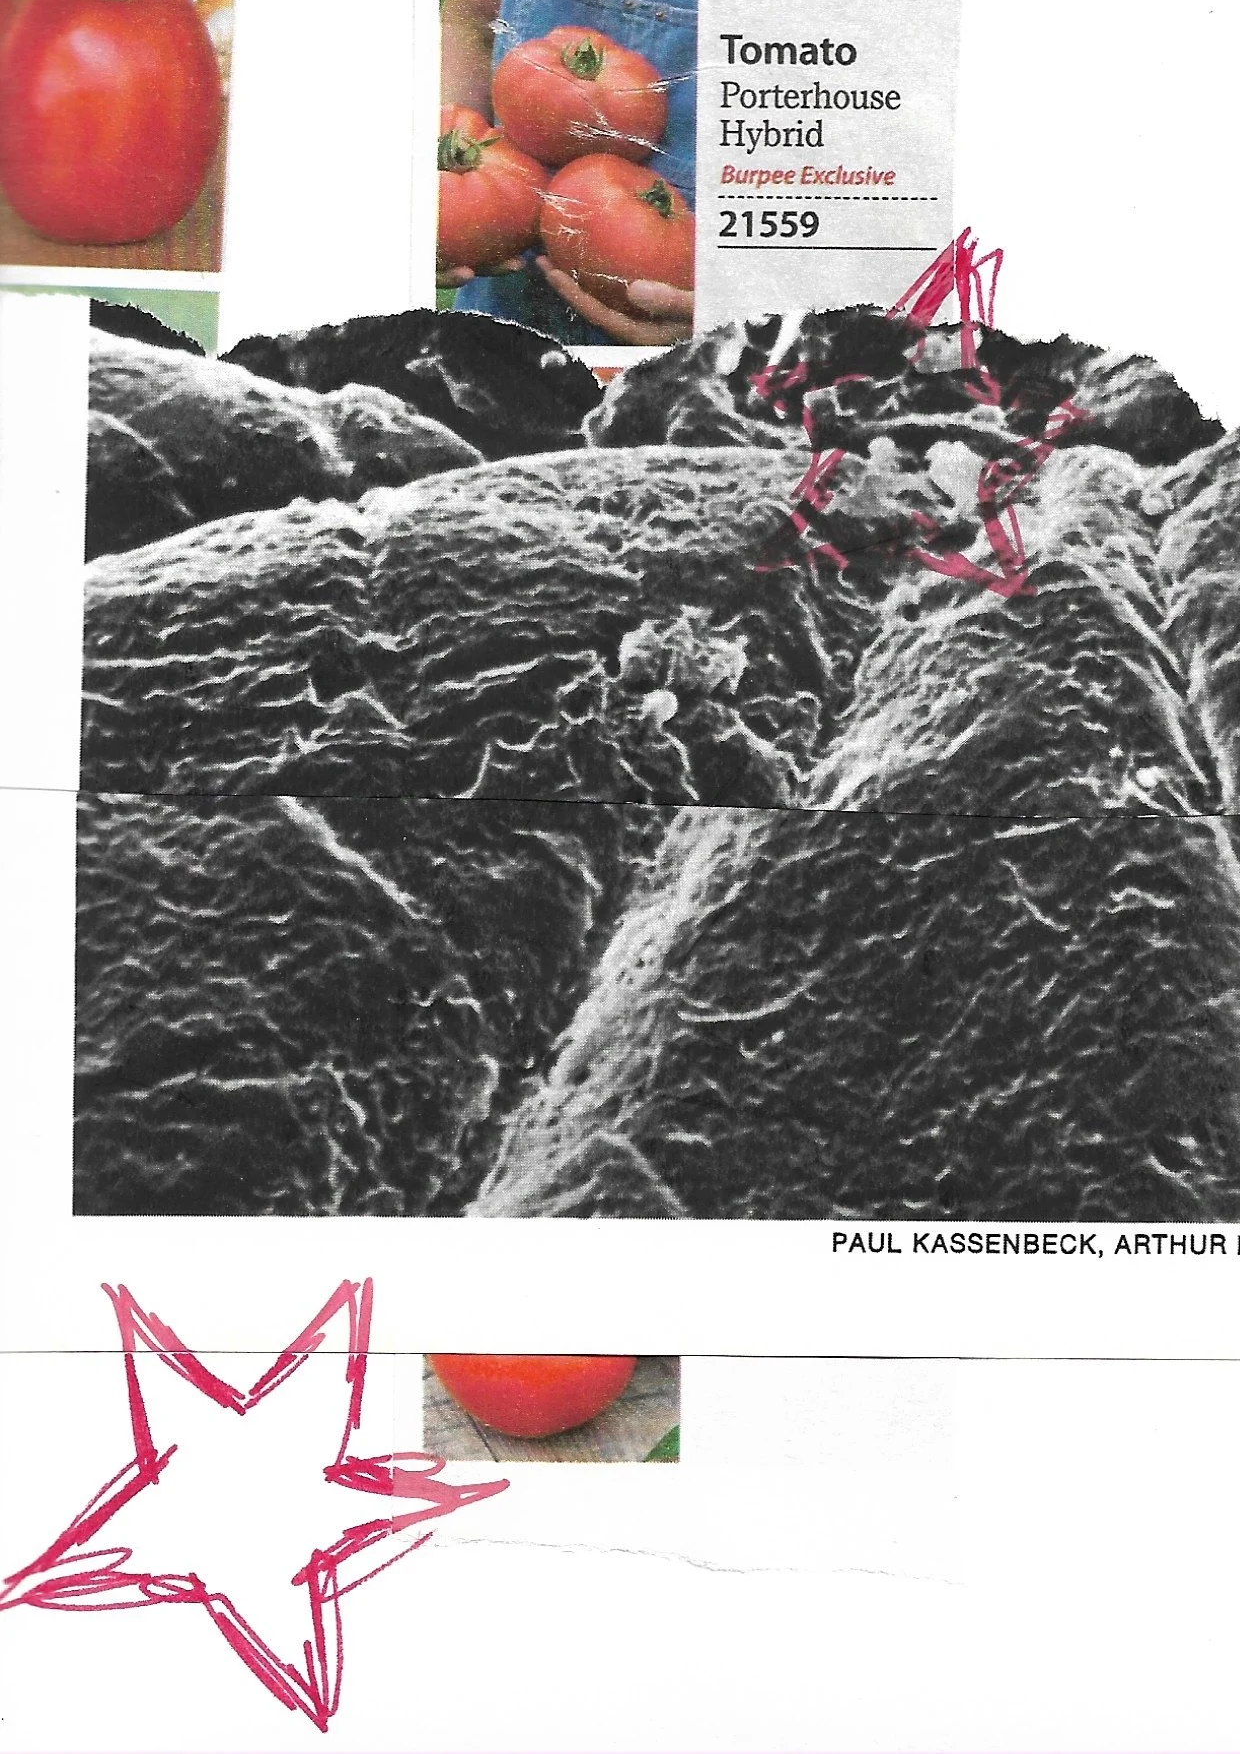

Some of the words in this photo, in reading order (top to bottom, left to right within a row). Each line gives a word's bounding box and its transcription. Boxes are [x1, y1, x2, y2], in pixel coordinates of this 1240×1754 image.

[720, 34, 858, 66] Tomato
[720, 81, 901, 110] Porterhouse
[719, 119, 825, 154] Hybrid
[720, 165, 796, 188] Burpee
[800, 165, 897, 186] Exclusive
[719, 211, 820, 238] 21559
[832, 1231, 902, 1254] PAUL
[912, 1232, 1105, 1259] KASSENBECK,
[1114, 1233, 1227, 1256] ARTHUR
